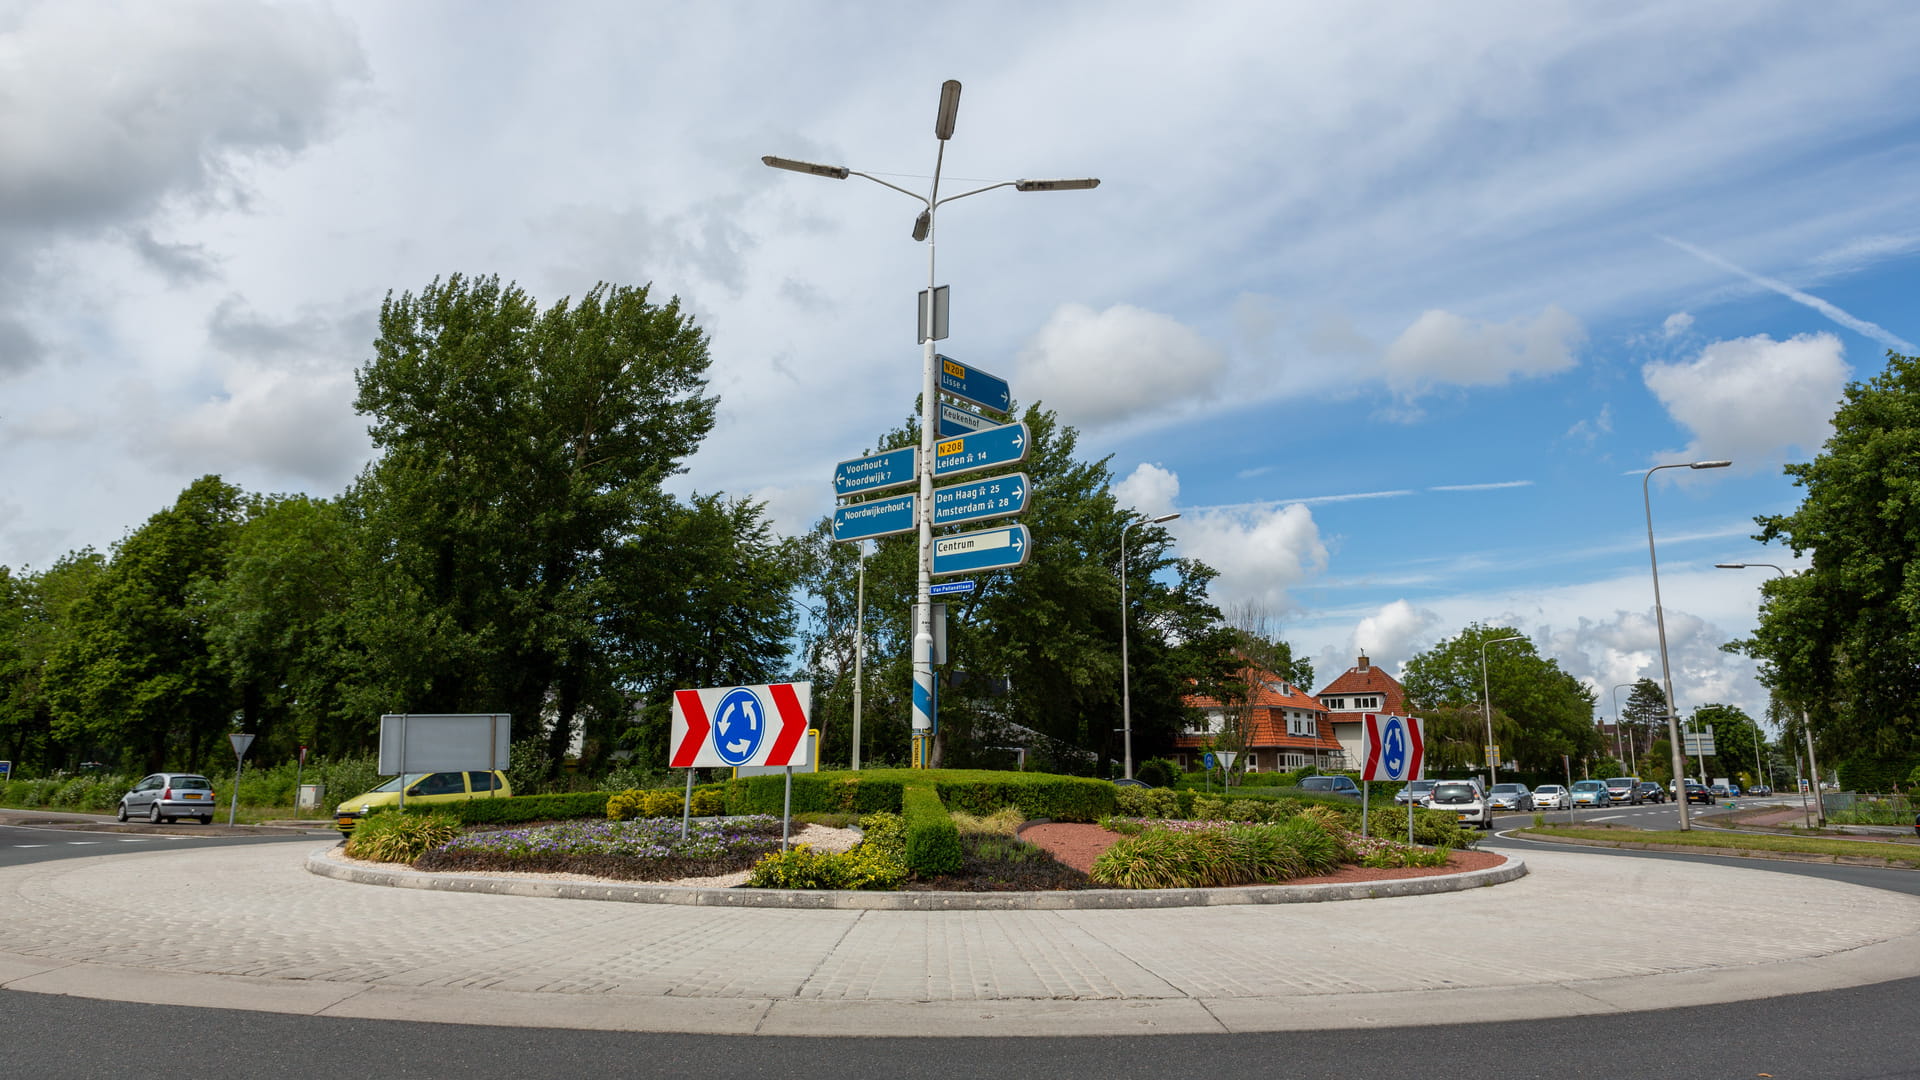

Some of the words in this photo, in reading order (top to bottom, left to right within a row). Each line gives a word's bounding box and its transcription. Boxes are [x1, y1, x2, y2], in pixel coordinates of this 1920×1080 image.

[943, 374, 961, 389] Lisse
[962, 383, 967, 391] 4
[943, 407, 980, 428] Keukenhof
[846, 459, 882, 474] Voorhout
[884, 458, 889, 466] 4
[937, 456, 965, 469] Leiden
[977, 451, 987, 460] 14
[845, 472, 885, 487] Noordwijk
[887, 471, 892, 479] 7
[937, 493, 953, 503] Den
[955, 489, 977, 499] Haag
[990, 484, 1000, 494] 25
[844, 502, 905, 520] Noordwijkerhout
[936, 502, 985, 518] Amsterdam
[998, 498, 1009, 507] 28
[937, 540, 975, 552] Centrum
